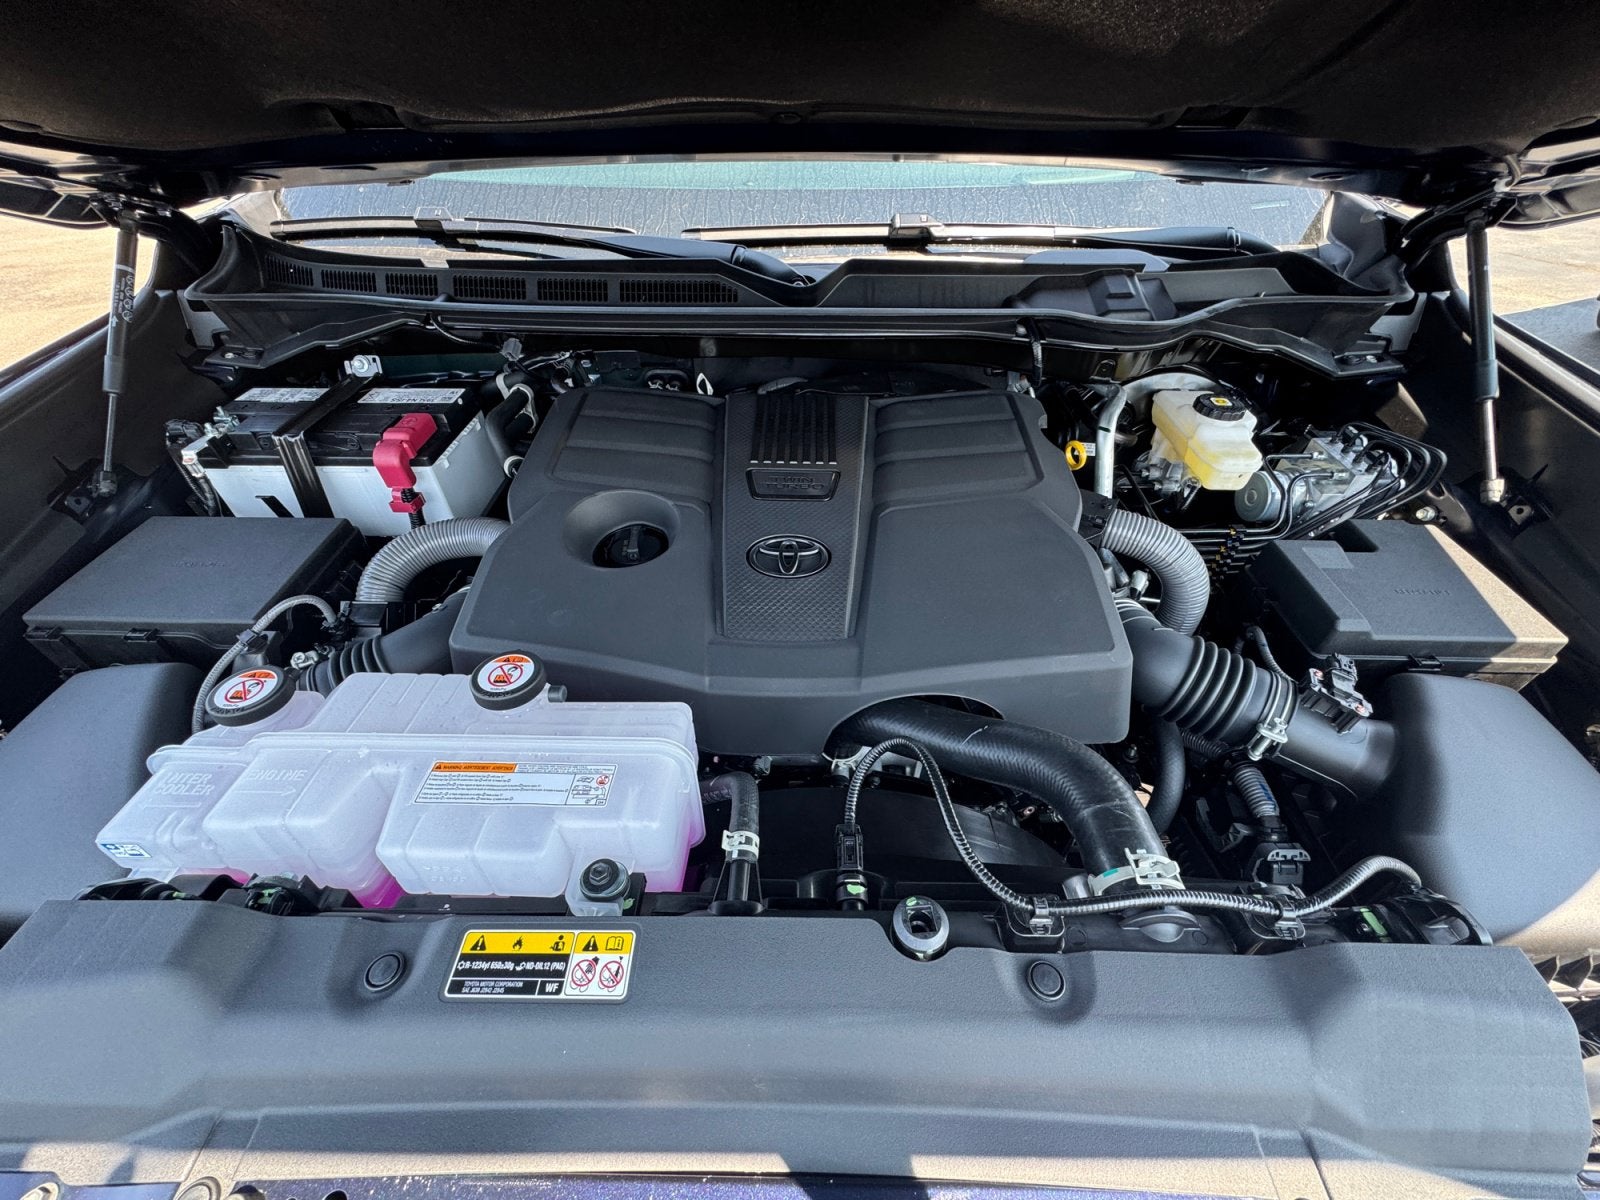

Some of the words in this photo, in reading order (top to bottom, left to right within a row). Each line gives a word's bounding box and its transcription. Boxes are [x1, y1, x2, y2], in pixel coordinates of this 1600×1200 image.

[164, 772, 213, 784] INTER
[247, 769, 308, 781] ENGINE
[153, 783, 215, 796] COOLER
[545, 982, 559, 993] WF
